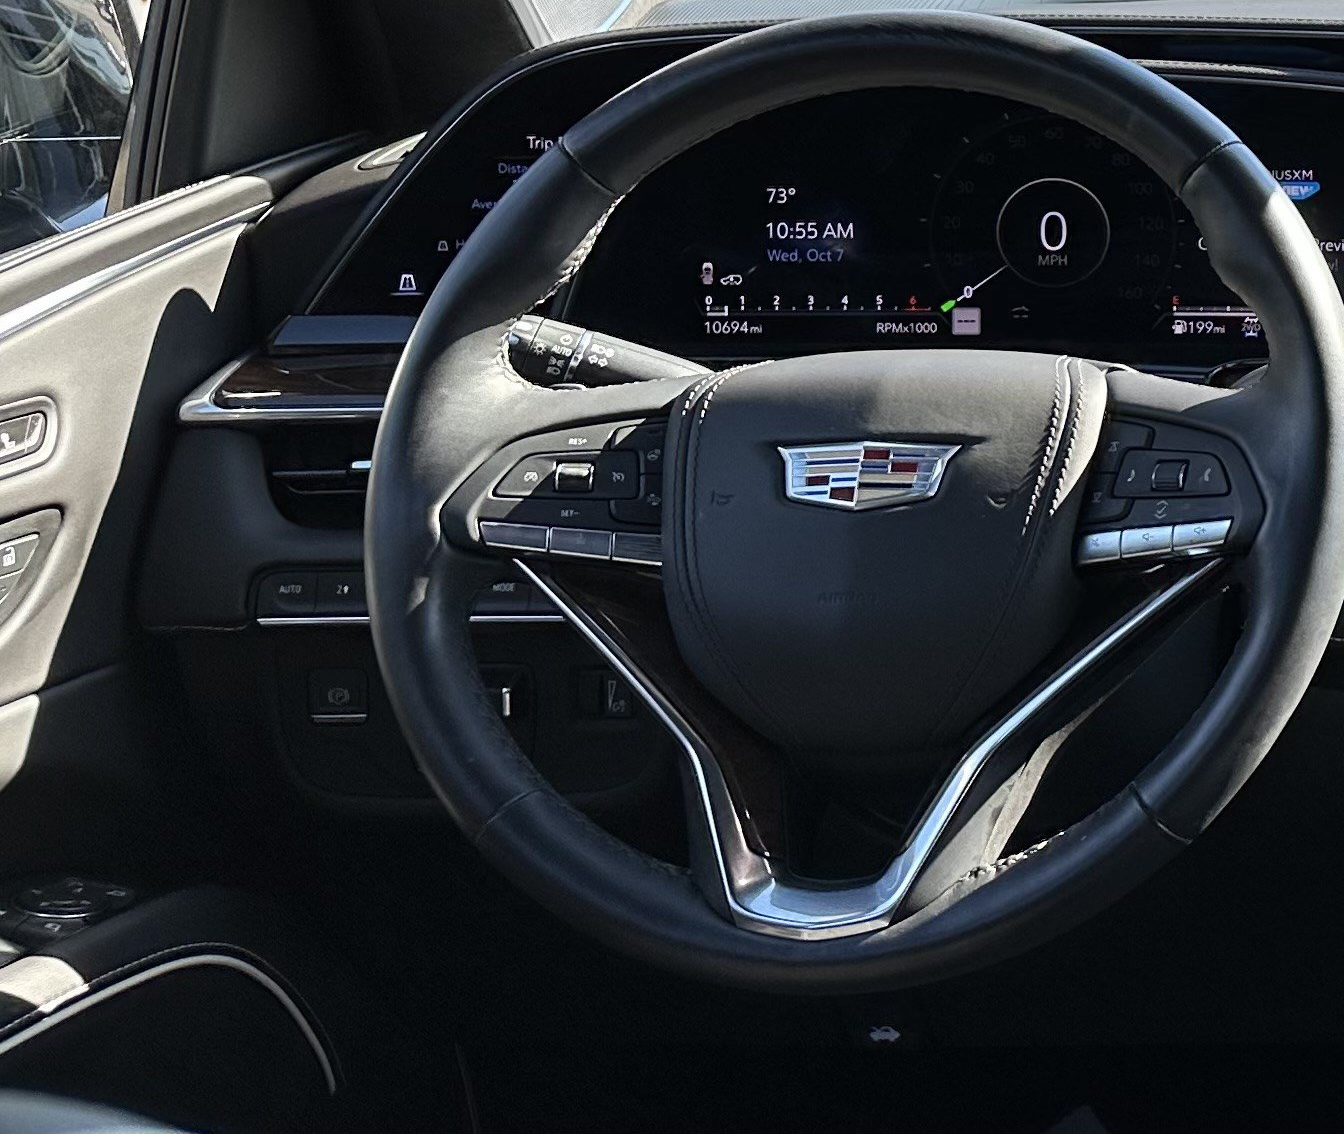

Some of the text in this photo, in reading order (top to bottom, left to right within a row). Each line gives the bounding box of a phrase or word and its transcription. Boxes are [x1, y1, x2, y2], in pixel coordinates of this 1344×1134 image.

[525, 135, 554, 152] Trip
[498, 162, 530, 175] Dista
[1272, 169, 1314, 181] IUSXM
[766, 187, 797, 205] 73°
[471, 198, 497, 210] Aver
[766, 222, 855, 241] 10:55 AM
[1039, 211, 1068, 252] 0
[767, 249, 845, 264] Wed, Oct 7
[1037, 255, 1069, 266] MPH
[963, 285, 973, 299] 0
[704, 295, 917, 306] 0 1 2 3 4 5 6
[1172, 295, 1180, 305] E
[876, 322, 938, 334] RPMx1000
[550, 344, 573, 357] AUTO
[278, 584, 302, 595] AUTO
